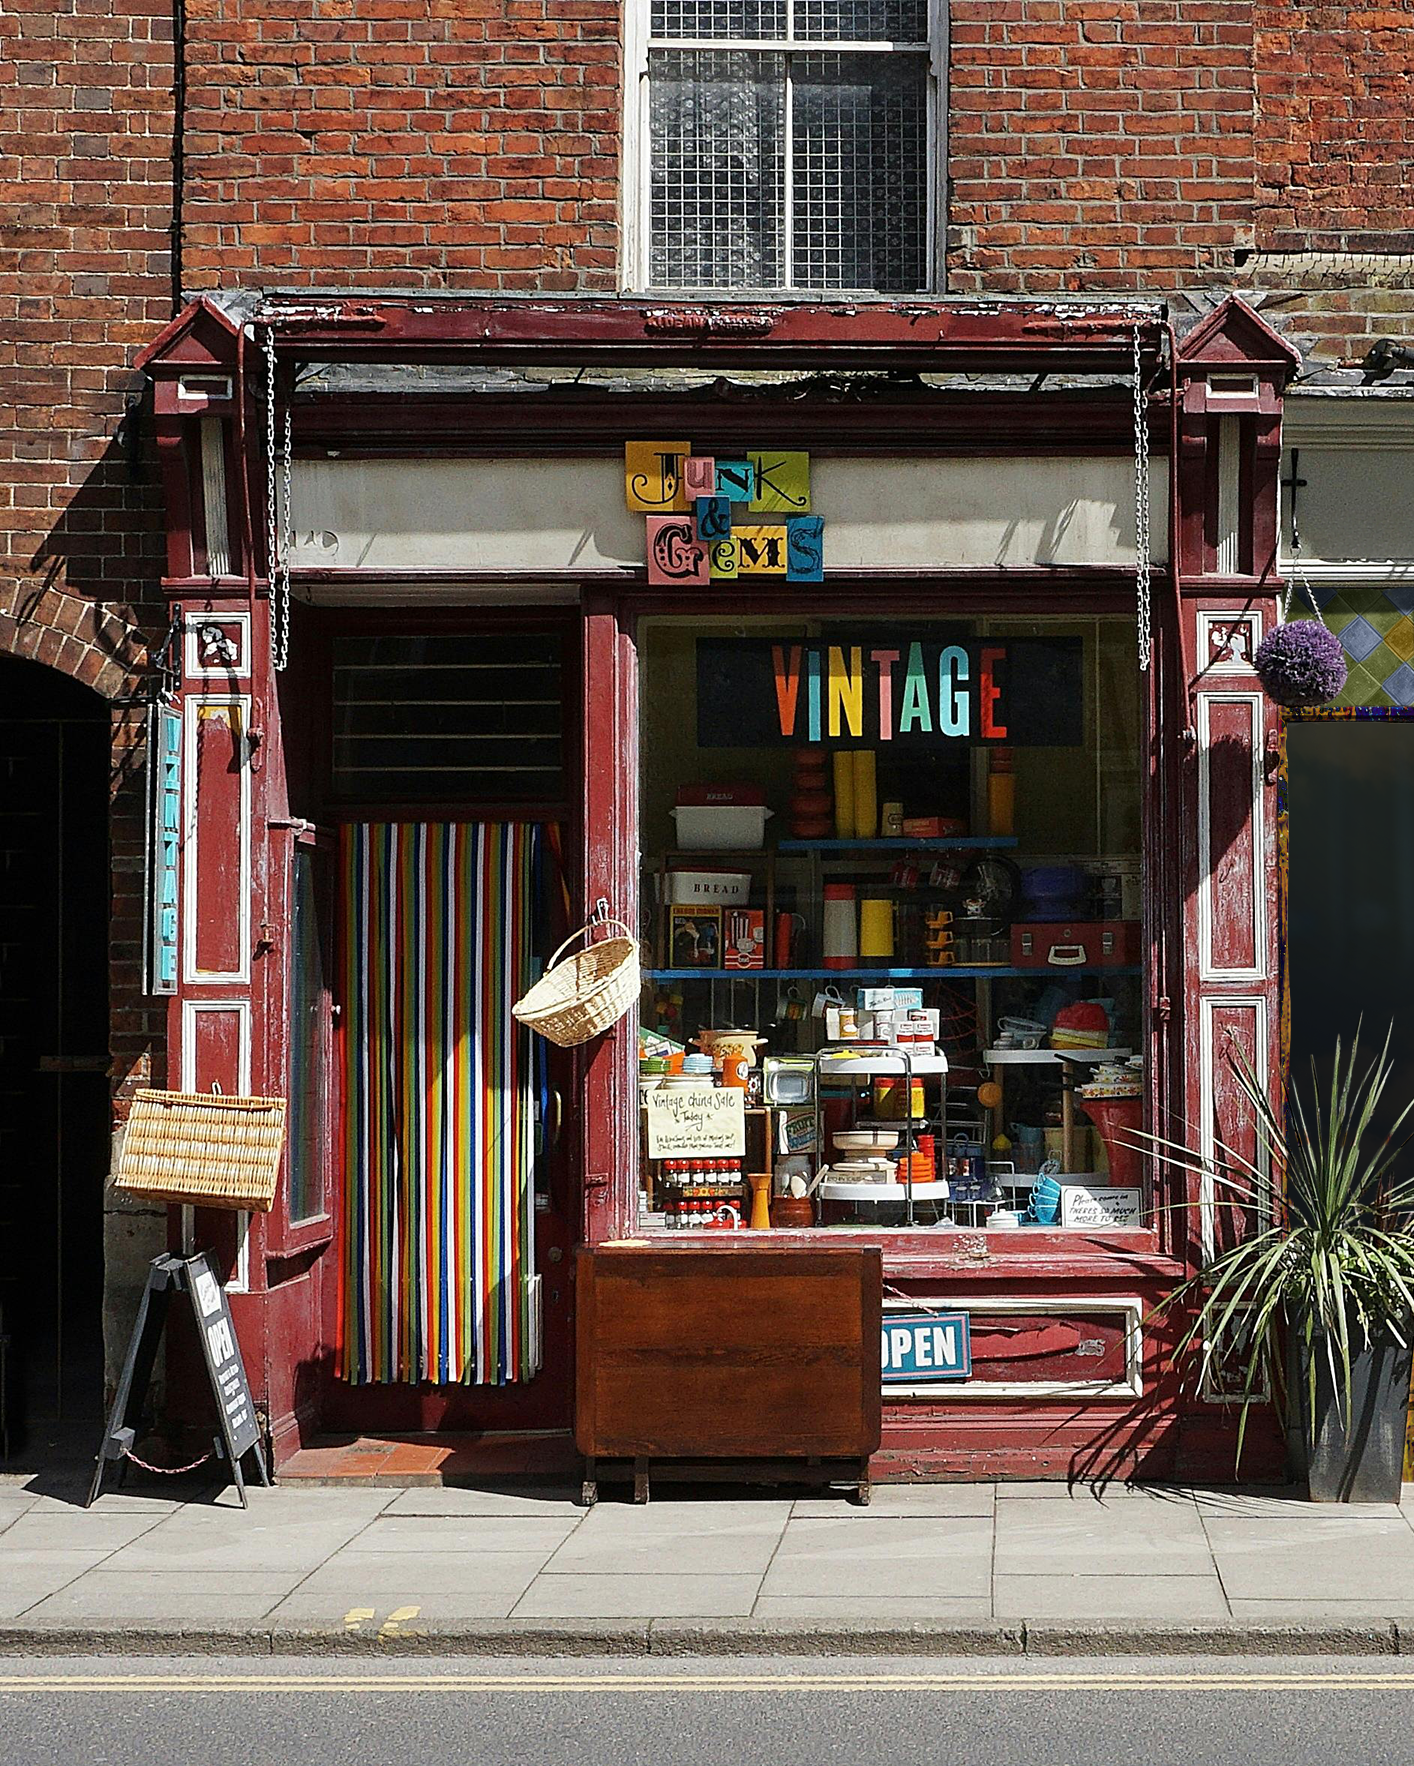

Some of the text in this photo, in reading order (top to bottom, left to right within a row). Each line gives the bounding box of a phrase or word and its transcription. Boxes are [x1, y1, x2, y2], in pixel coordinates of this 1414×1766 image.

[701, 496, 729, 538] &
[771, 641, 1008, 742] VINTAGE
[693, 883, 739, 894] BREAD
[652, 1093, 684, 1118] Vintage
[714, 1091, 736, 1110] Sale
[207, 1316, 235, 1368] OPEN
